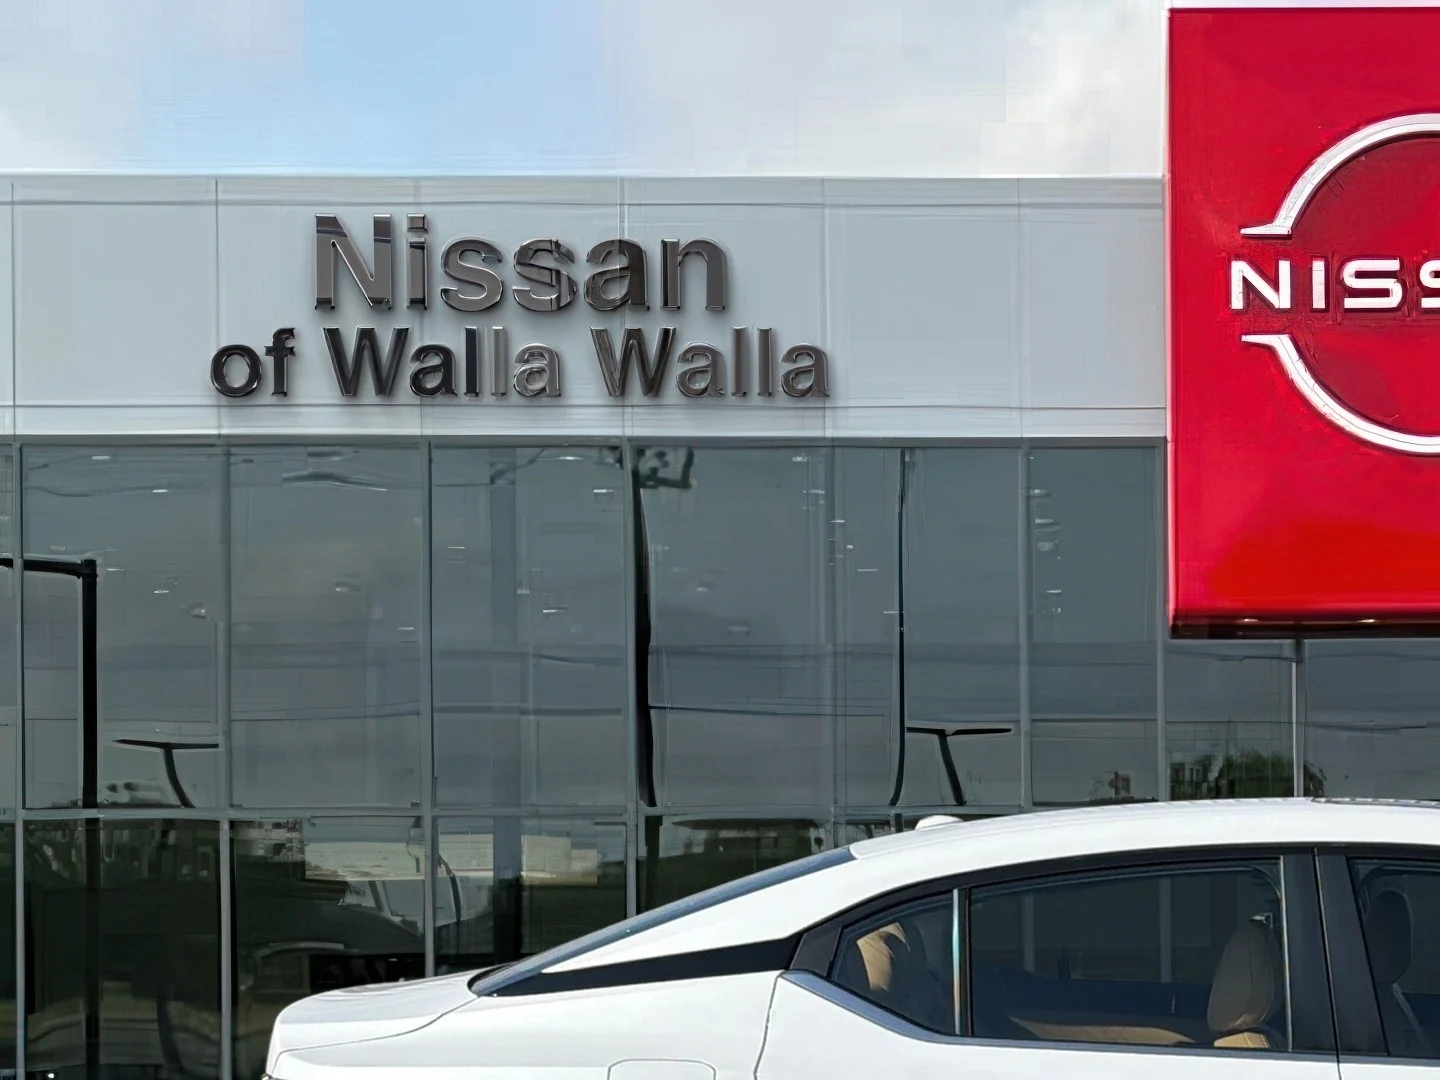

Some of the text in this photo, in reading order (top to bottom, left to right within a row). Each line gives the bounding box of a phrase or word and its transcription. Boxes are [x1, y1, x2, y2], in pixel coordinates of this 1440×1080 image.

[312, 212, 729, 311] Nissan
[209, 325, 830, 398] of Walla Walla
